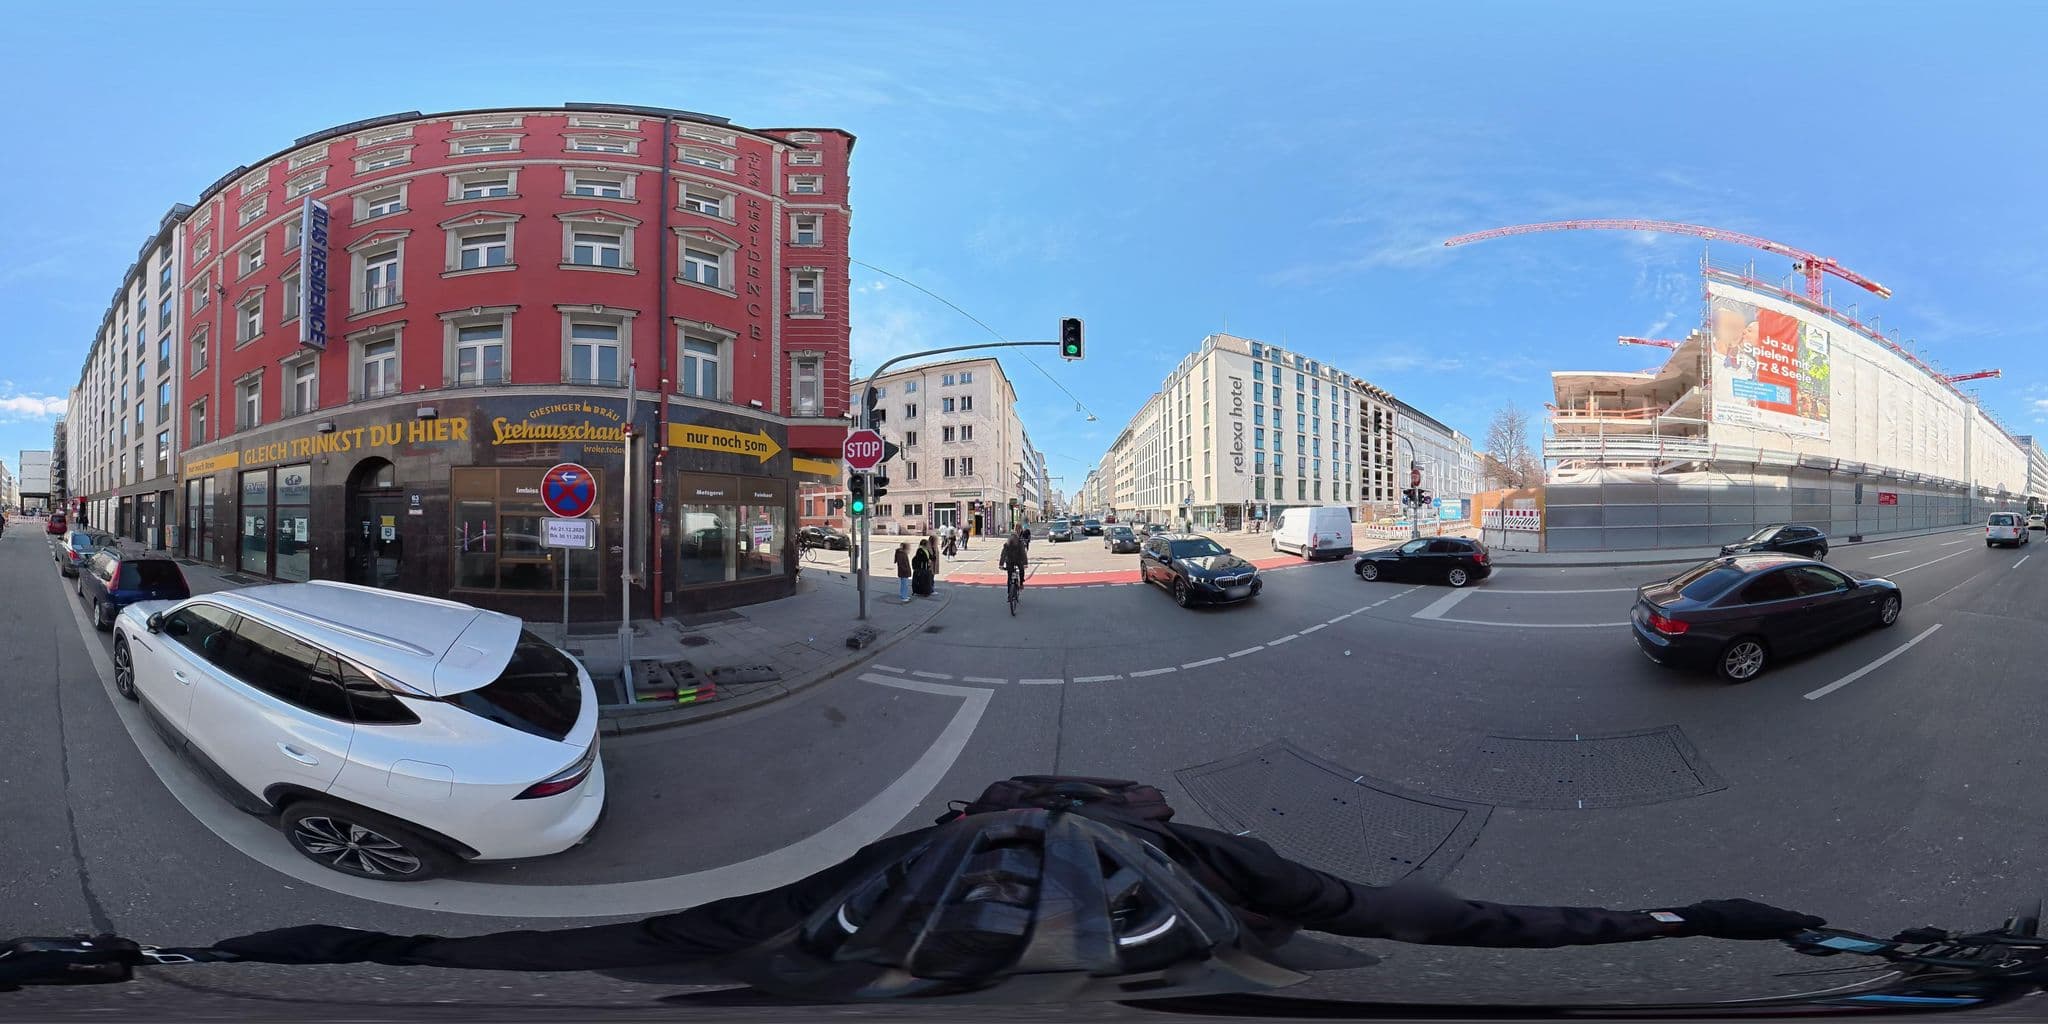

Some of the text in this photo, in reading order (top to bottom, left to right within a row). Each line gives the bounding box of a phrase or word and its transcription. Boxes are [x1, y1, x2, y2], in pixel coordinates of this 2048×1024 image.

[310, 206, 328, 345] ATLAS RESIDENCE
[747, 200, 761, 341] RESIDENCE
[1743, 342, 1789, 363] Spielen
[1762, 335, 1794, 352] Ja zu
[1736, 353, 1815, 384] Herz & Seele.
[529, 403, 620, 421] GIESINGER BRÄU
[1228, 376, 1244, 473] relexa hotel
[244, 416, 470, 466] GLEICH TRINKST DU HIER
[686, 432, 768, 452] nur noch 50m
[847, 441, 880, 458] STOP
